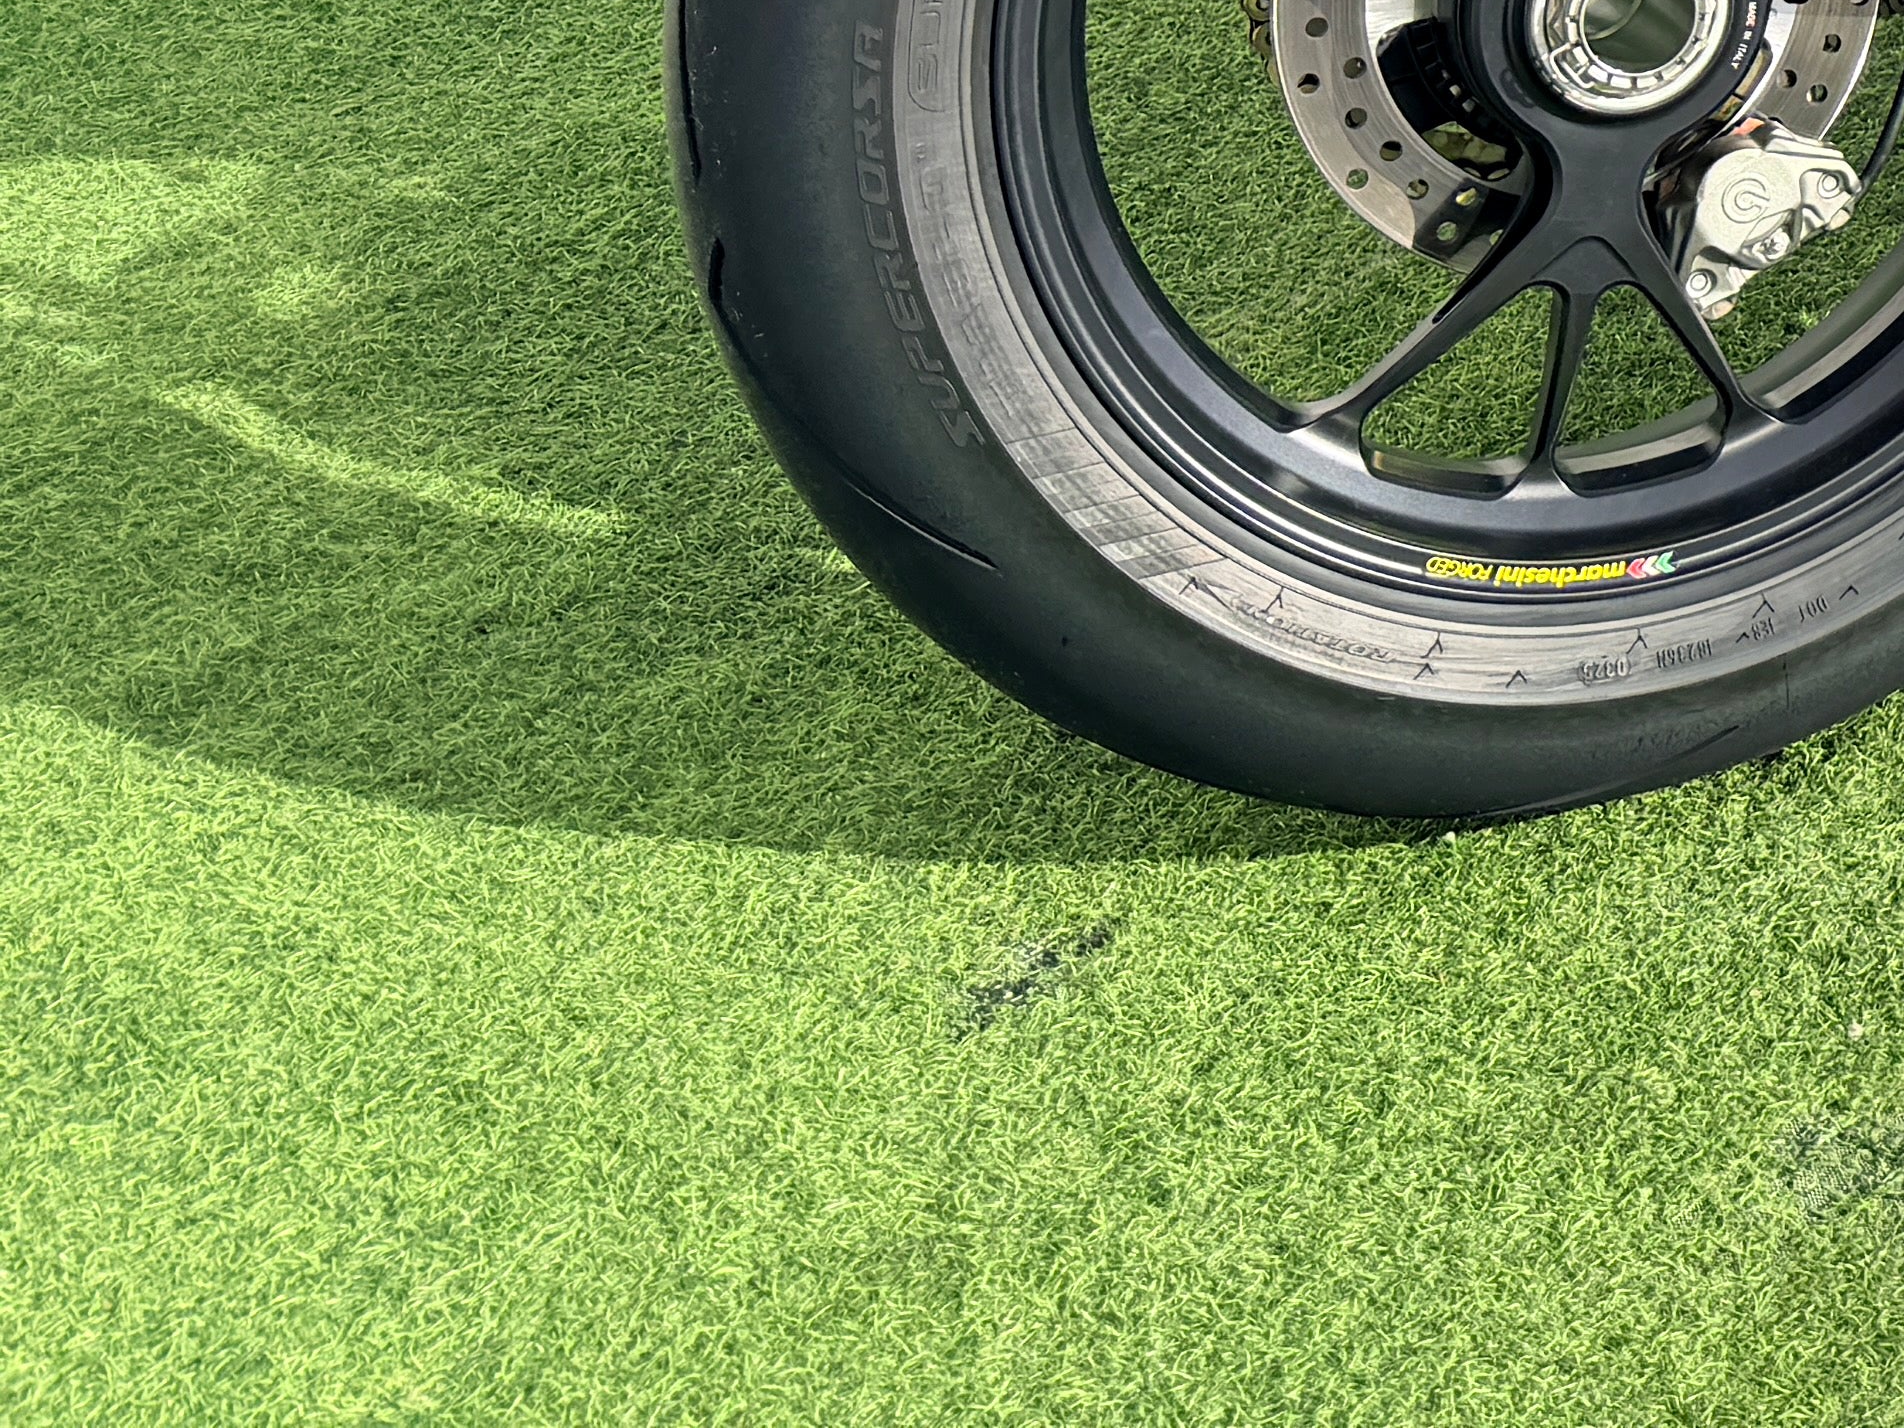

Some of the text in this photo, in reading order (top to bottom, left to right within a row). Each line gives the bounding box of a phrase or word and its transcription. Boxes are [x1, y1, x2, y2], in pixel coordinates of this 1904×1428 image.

[852, 18, 986, 448] SUPERCORSA
[1425, 555, 1627, 588] marchesini FORGED
